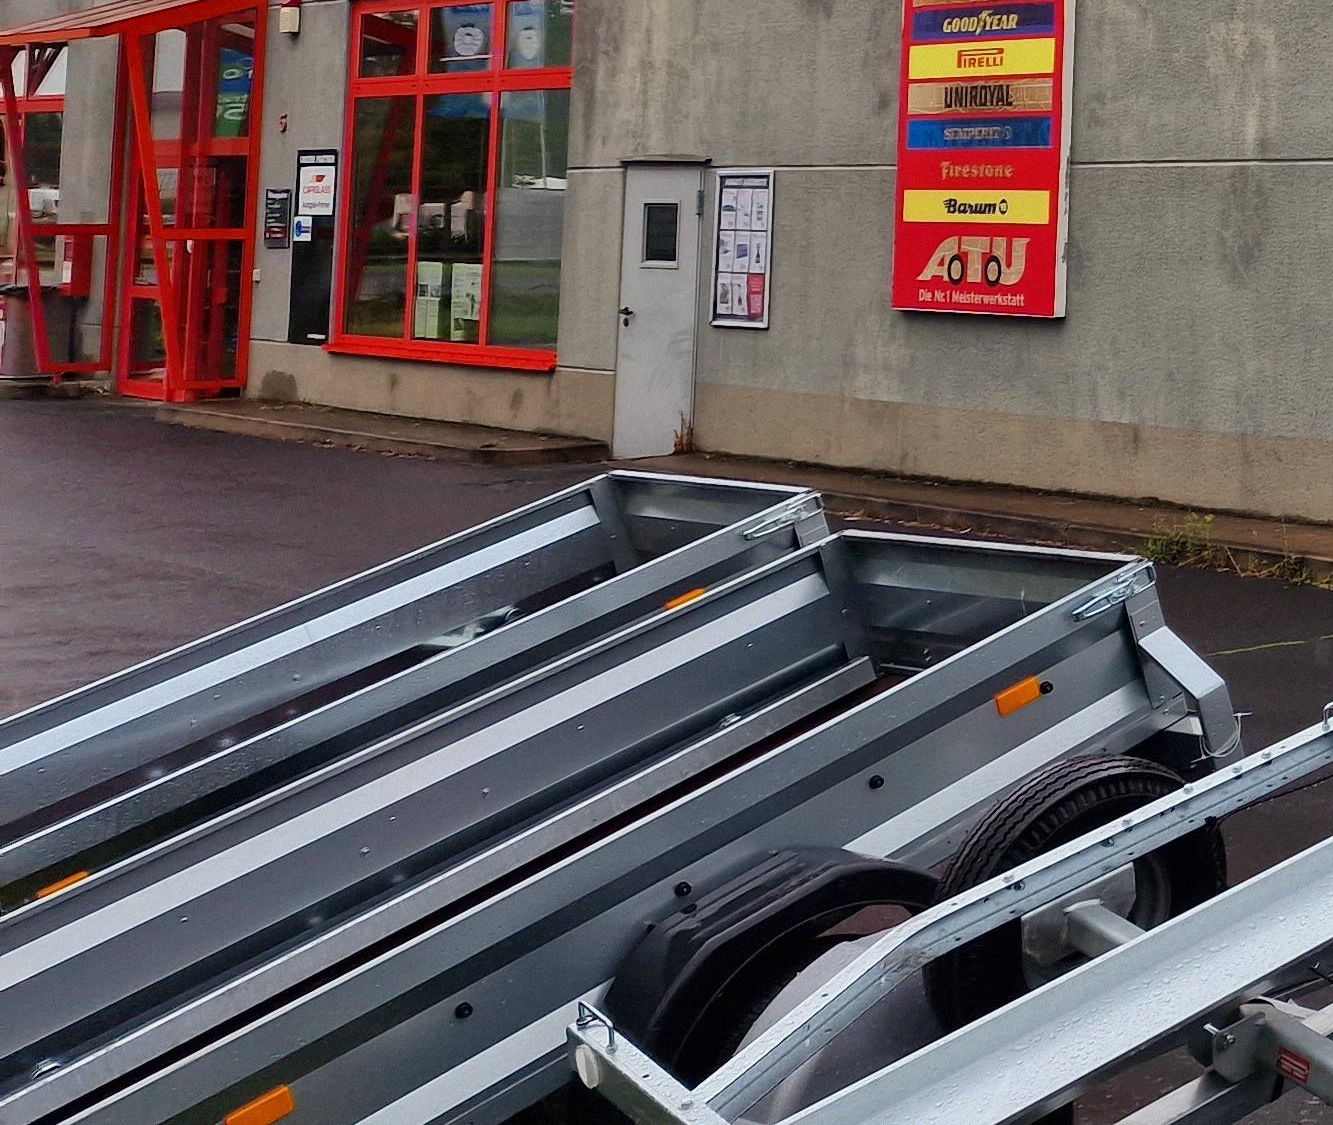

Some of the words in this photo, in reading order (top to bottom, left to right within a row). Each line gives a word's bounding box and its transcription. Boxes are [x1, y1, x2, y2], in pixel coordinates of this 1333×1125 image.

[943, 10, 1018, 35] GOODYEAR
[957, 48, 1004, 68] PIRELLI
[944, 84, 1014, 108] UNIROYAL
[940, 161, 1014, 180] Firestone
[943, 198, 997, 214] Barum
[915, 236, 1032, 285] ATU
[919, 289, 932, 303] Die
[952, 290, 1024, 306] Meisterwerkstatt
